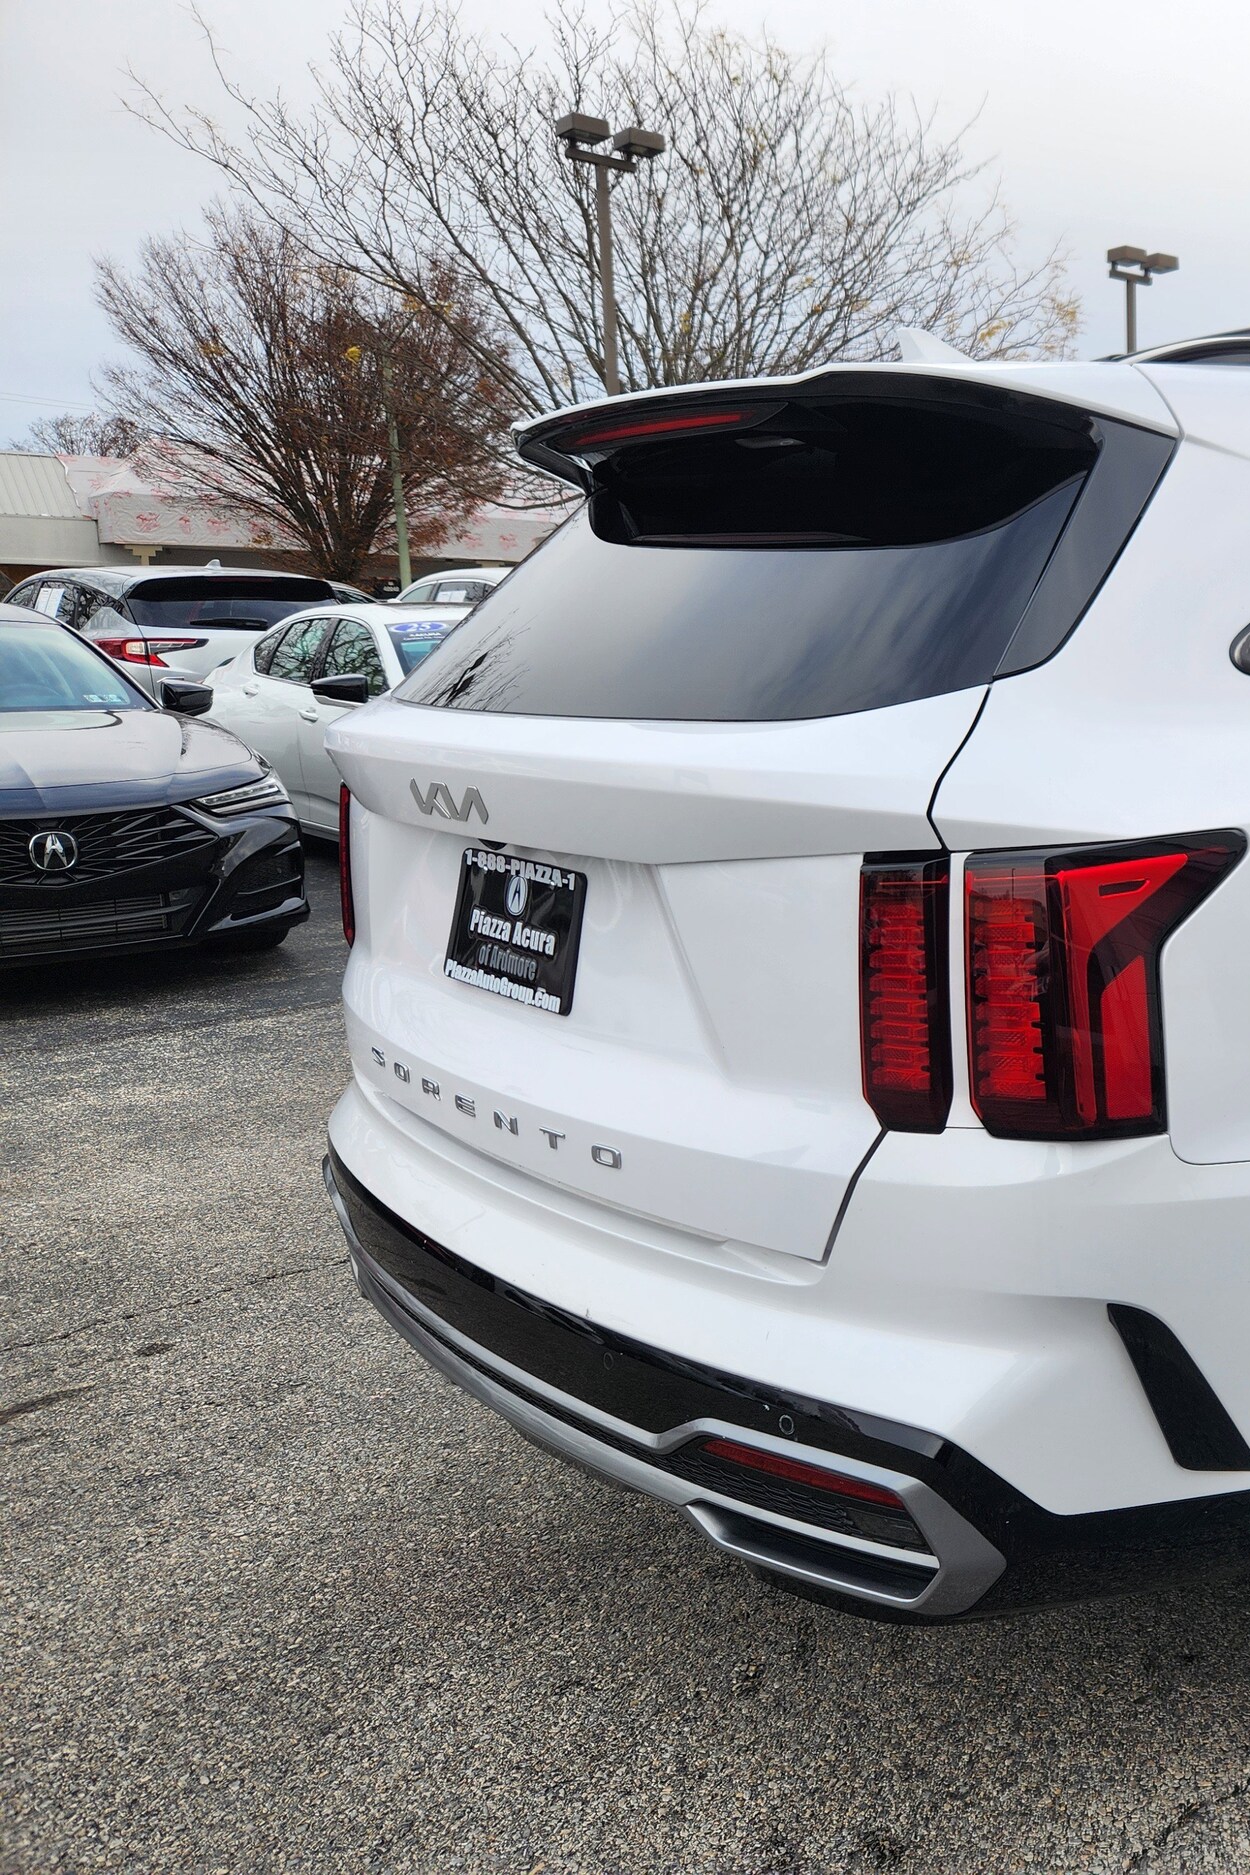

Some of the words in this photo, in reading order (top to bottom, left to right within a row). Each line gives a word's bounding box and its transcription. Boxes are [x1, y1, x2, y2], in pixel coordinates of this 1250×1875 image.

[409, 777, 489, 825] KIA
[465, 849, 575, 891] 1-888-PIAZZA-1
[469, 908, 511, 943] Piazza
[511, 921, 556, 956] Acura
[478, 943, 493, 966] of
[489, 945, 537, 981] Ardmore
[371, 1046, 623, 1170] SORENTO
